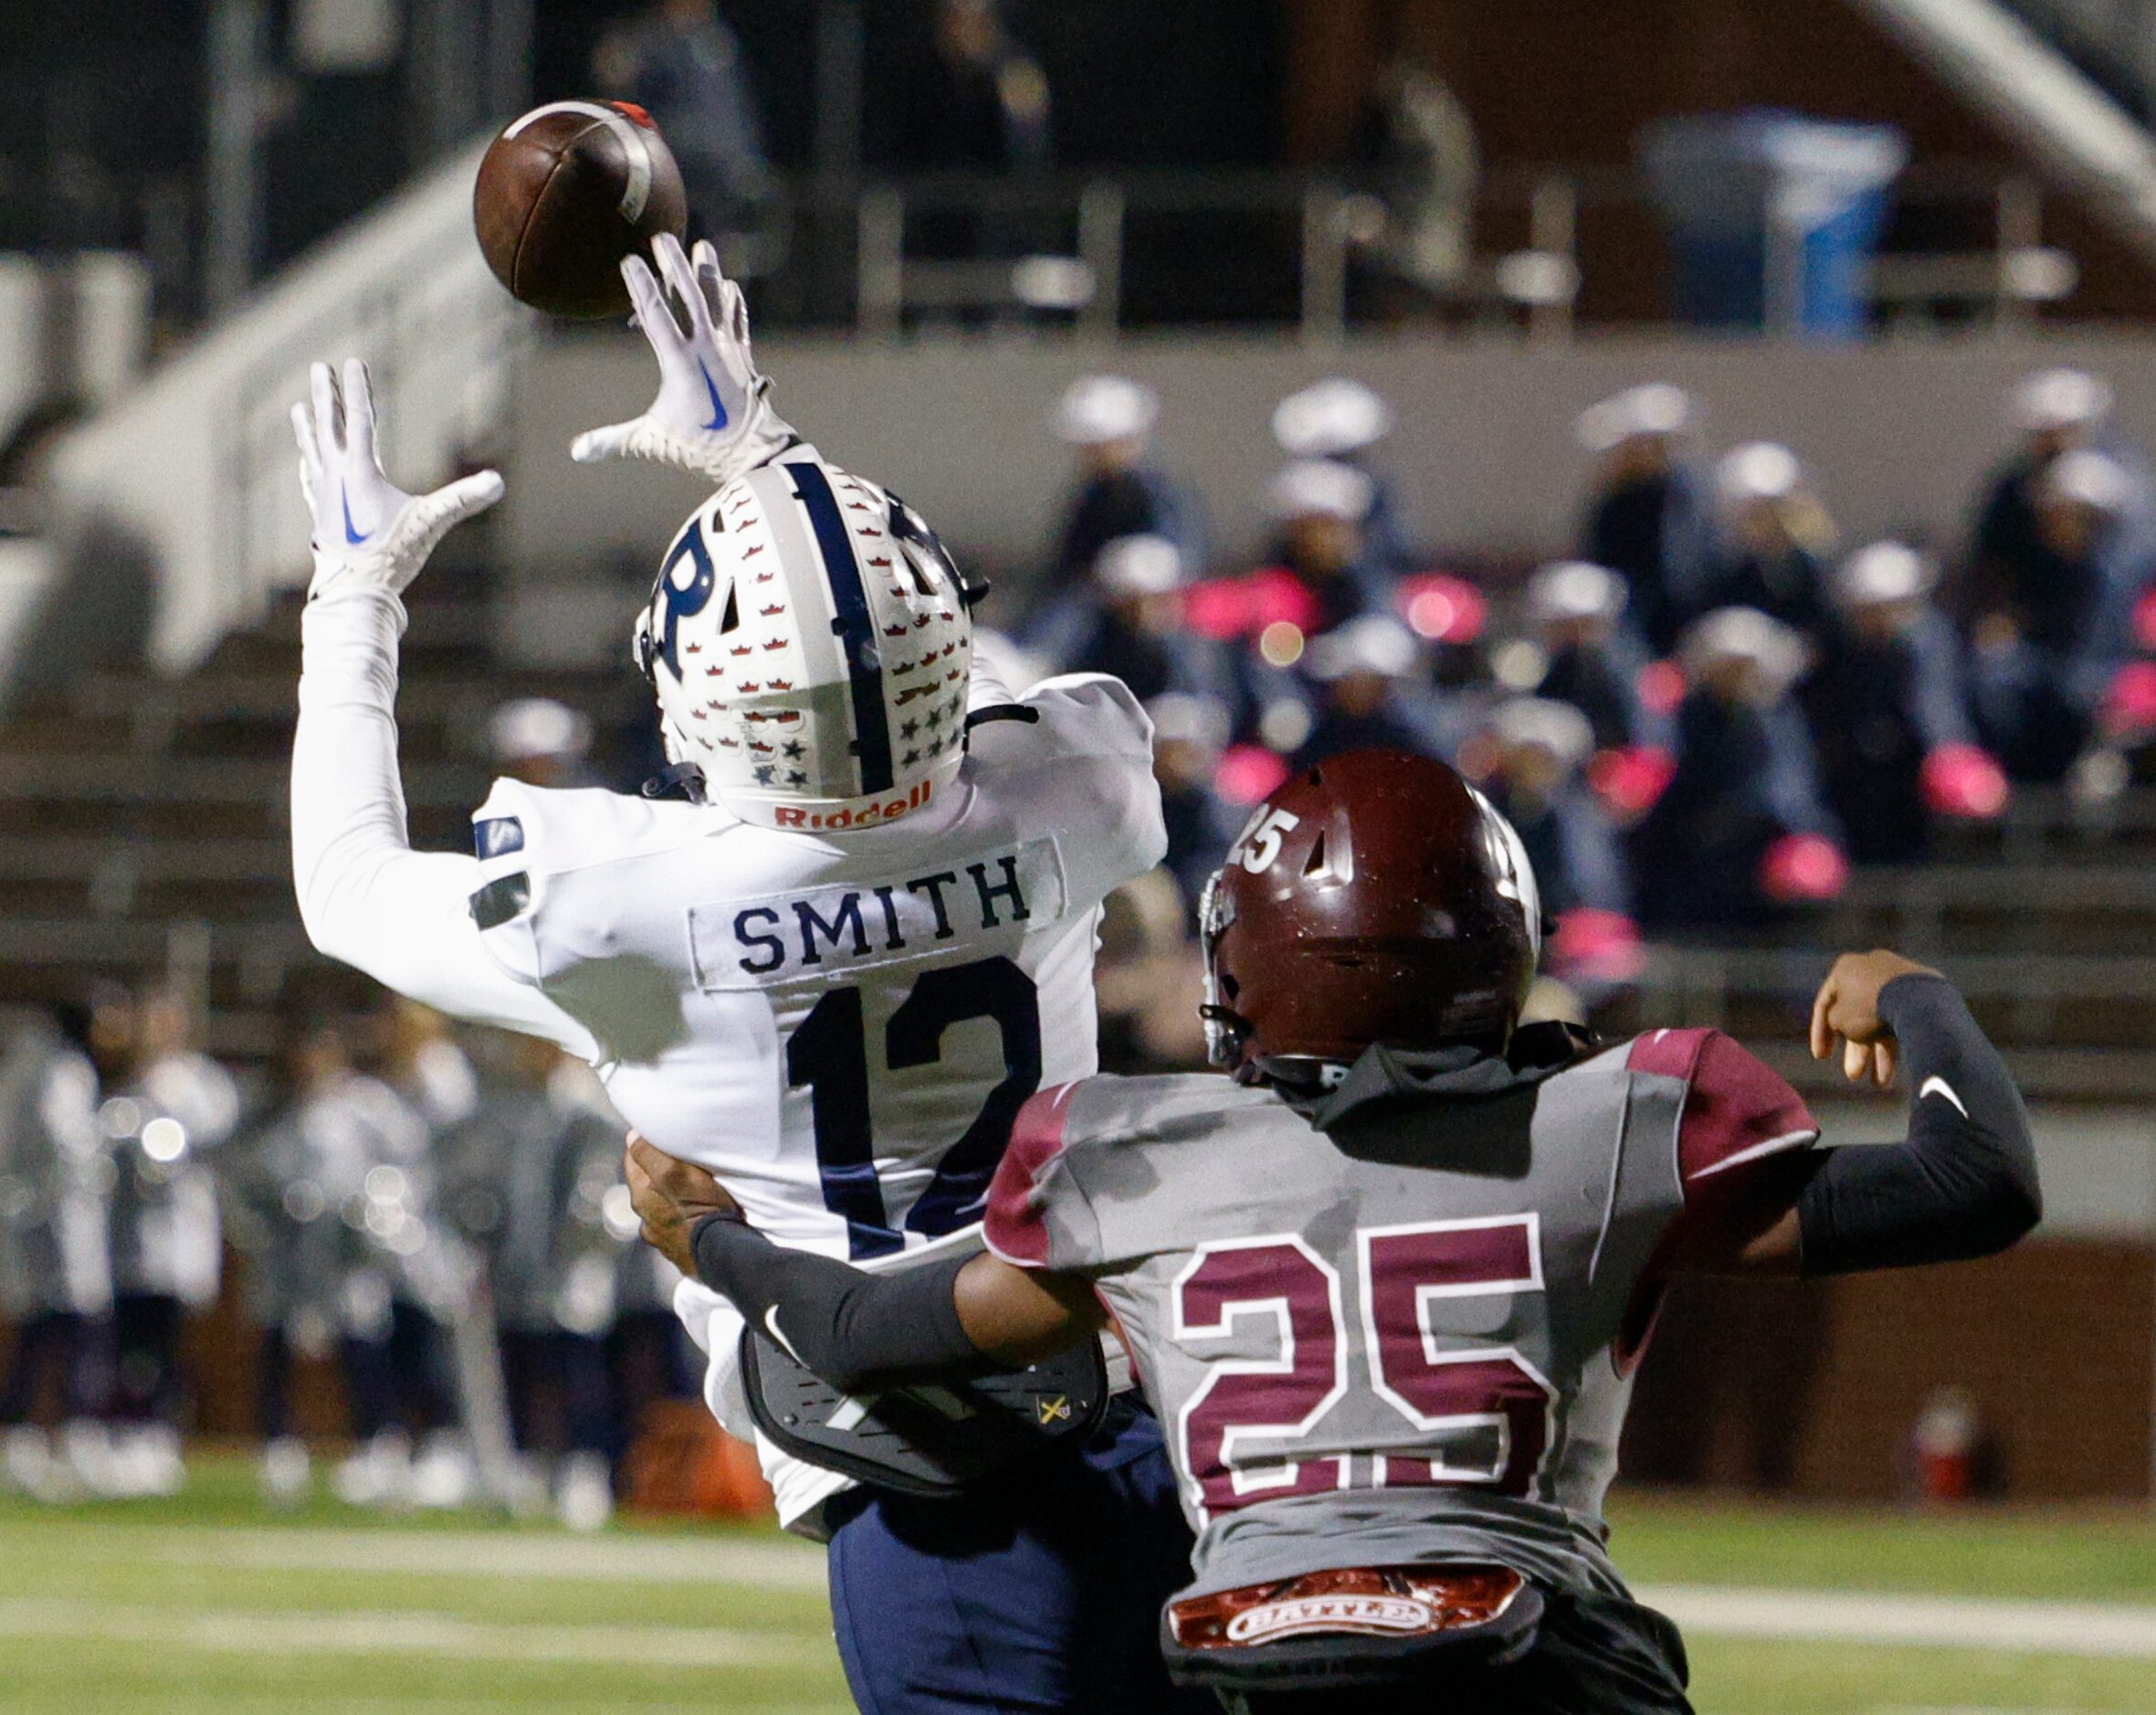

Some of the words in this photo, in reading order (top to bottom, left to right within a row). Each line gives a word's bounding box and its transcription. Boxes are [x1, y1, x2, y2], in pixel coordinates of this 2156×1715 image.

[774, 779, 931, 829] Riddell
[733, 856, 1030, 974] SMITH
[787, 956, 1042, 1259] 12
[1171, 1213, 1557, 1525] 25
